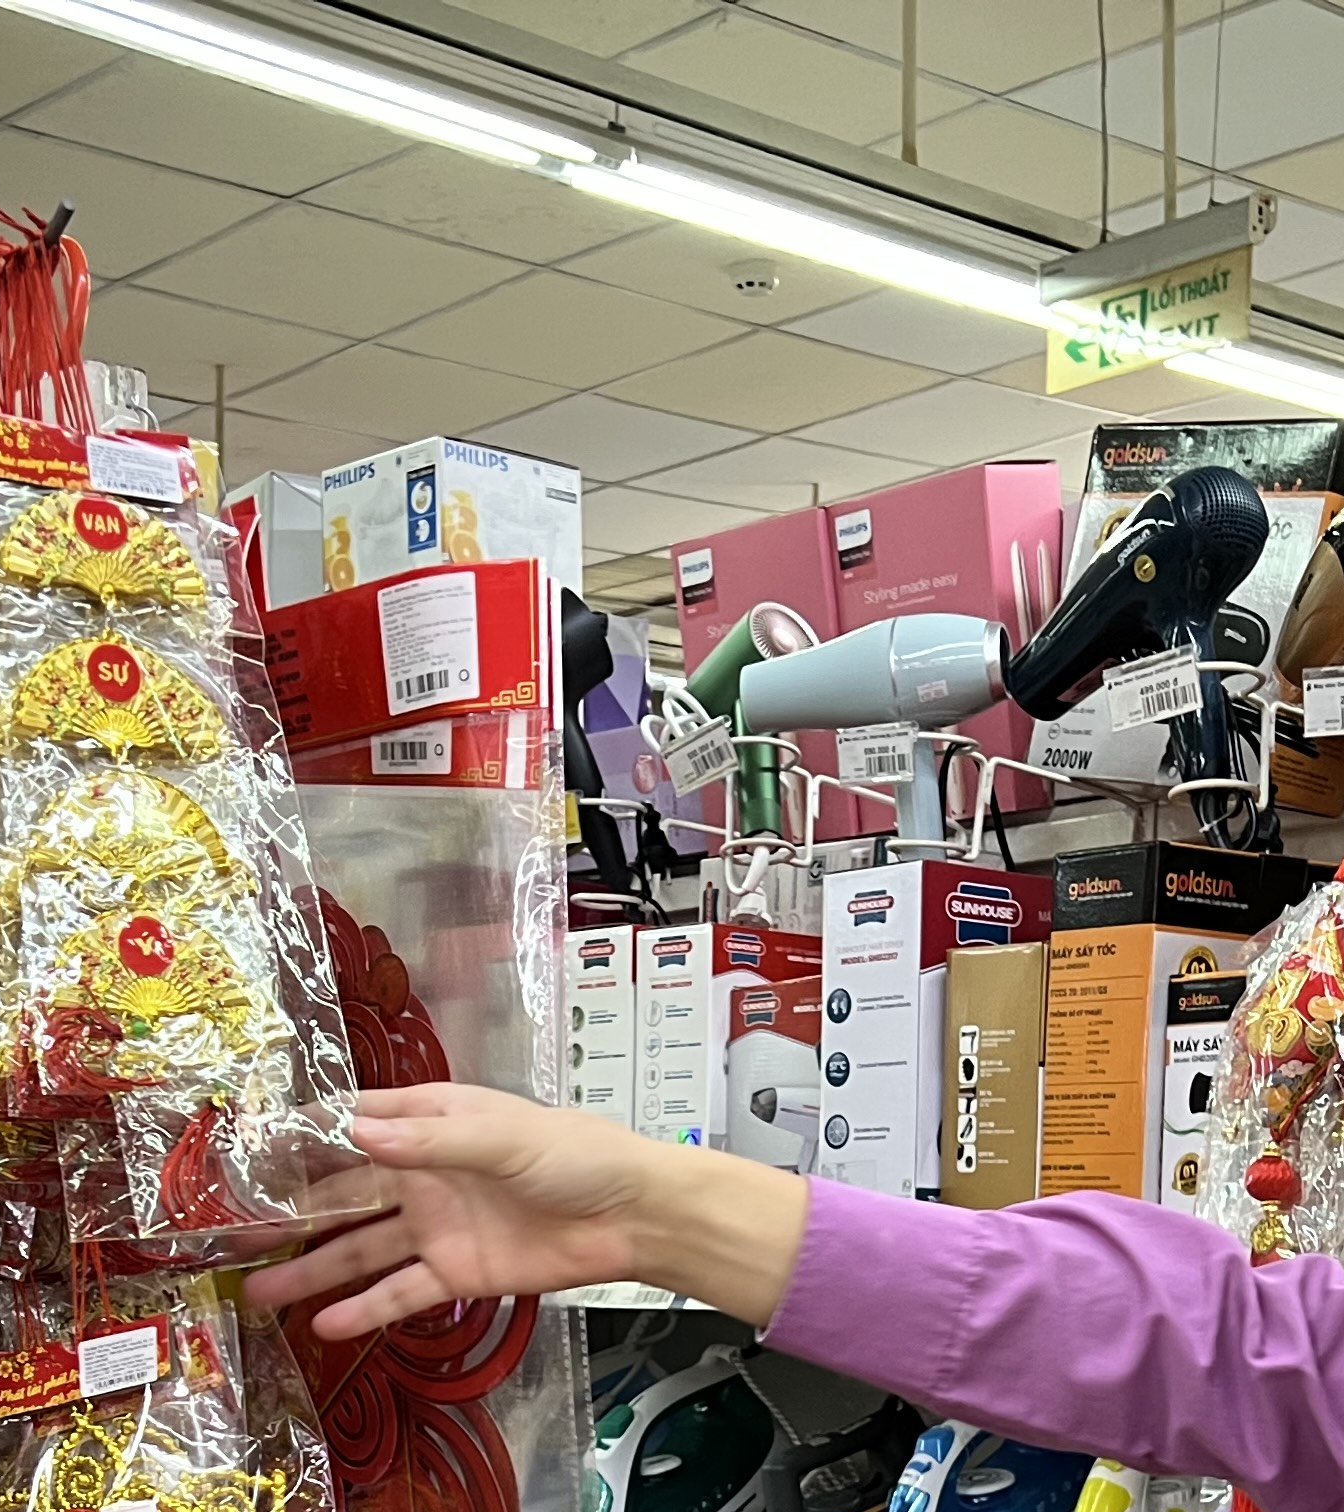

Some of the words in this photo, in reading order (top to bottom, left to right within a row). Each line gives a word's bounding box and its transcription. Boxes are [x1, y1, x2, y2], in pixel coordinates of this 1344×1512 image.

[443, 443, 508, 472] PHILIPS
[324, 462, 375, 491] PHILIPS
[98, 661, 130, 687] SỰ
[1042, 748, 1093, 770] 2000W
[1068, 877, 1123, 901] goldsun
[1165, 869, 1235, 898] goldsun
[951, 899, 1014, 920] SUNHOUSE
[1096, 942, 1117, 957] TÓC
[1178, 992, 1221, 1011] goldsun
[1173, 1038, 1199, 1053] MÁY
